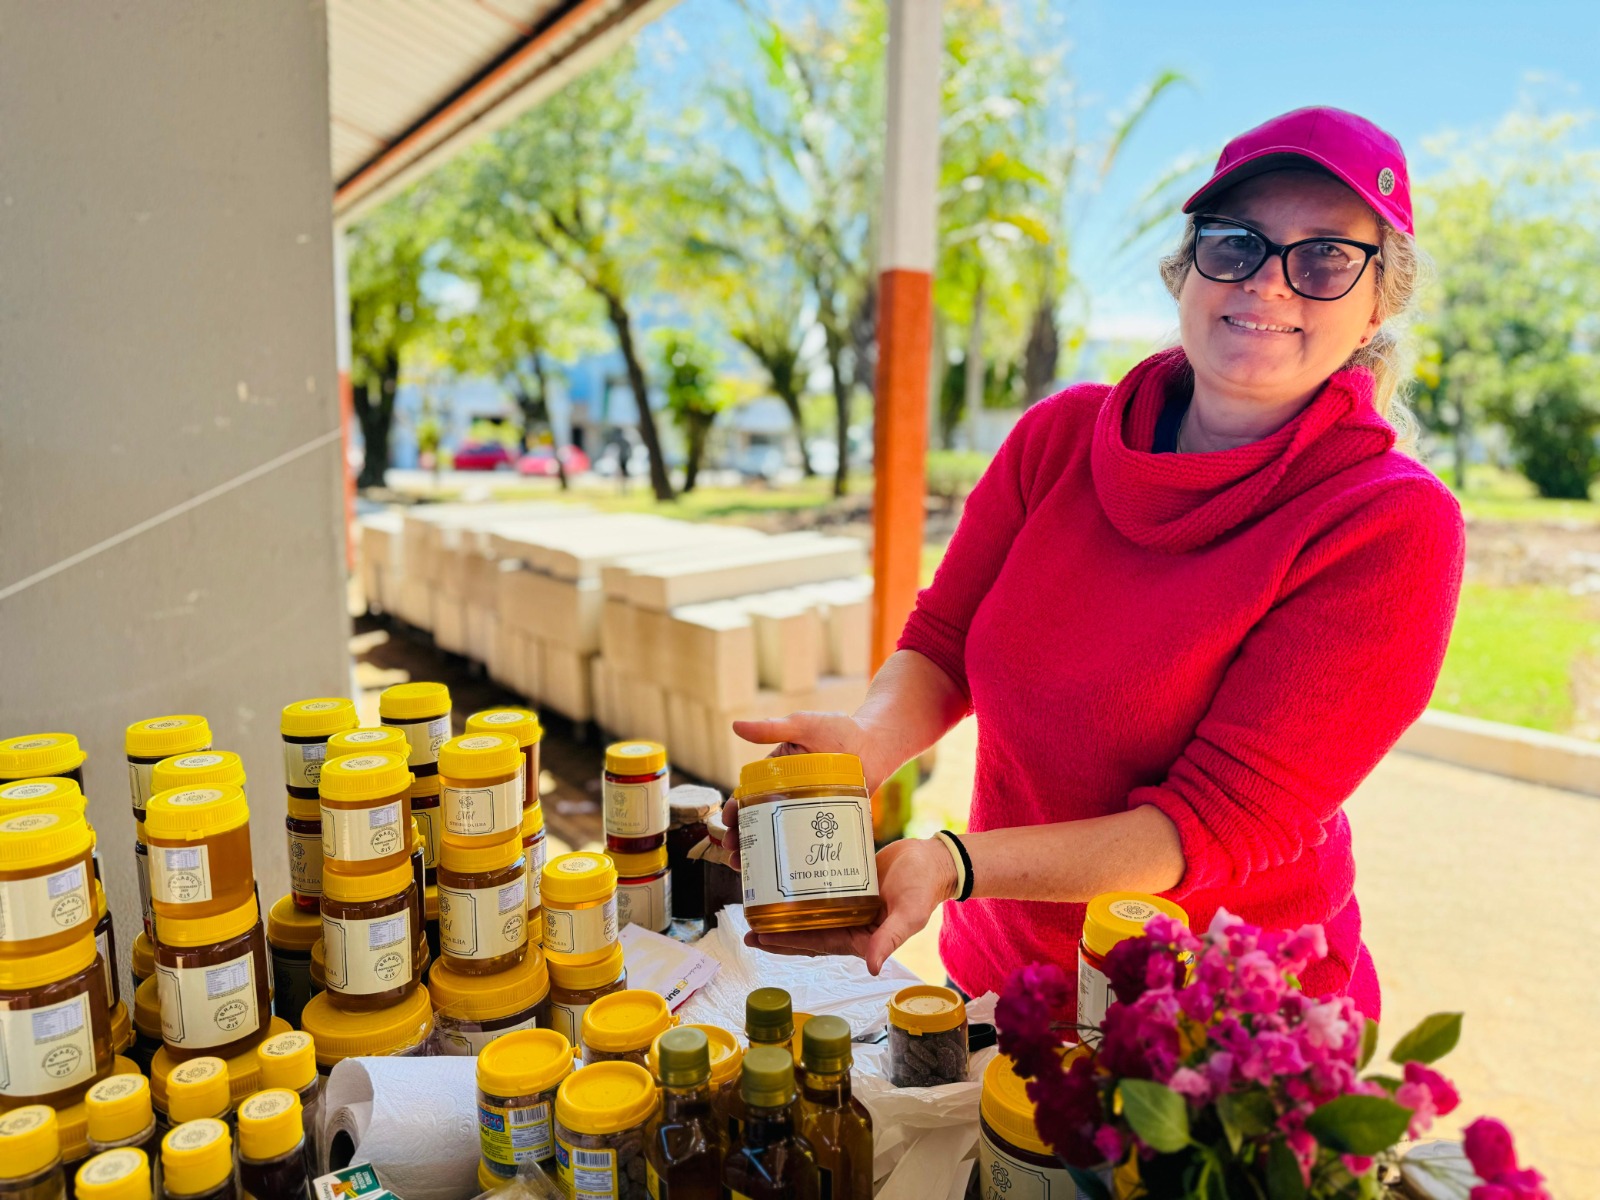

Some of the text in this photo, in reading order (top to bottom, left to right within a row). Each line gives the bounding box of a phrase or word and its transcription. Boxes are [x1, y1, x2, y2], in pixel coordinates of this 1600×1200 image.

[804, 841, 843, 866] Mel
[814, 869, 829, 878] RIO
[830, 869, 843, 877] DA
[843, 867, 860, 876] ILHA
